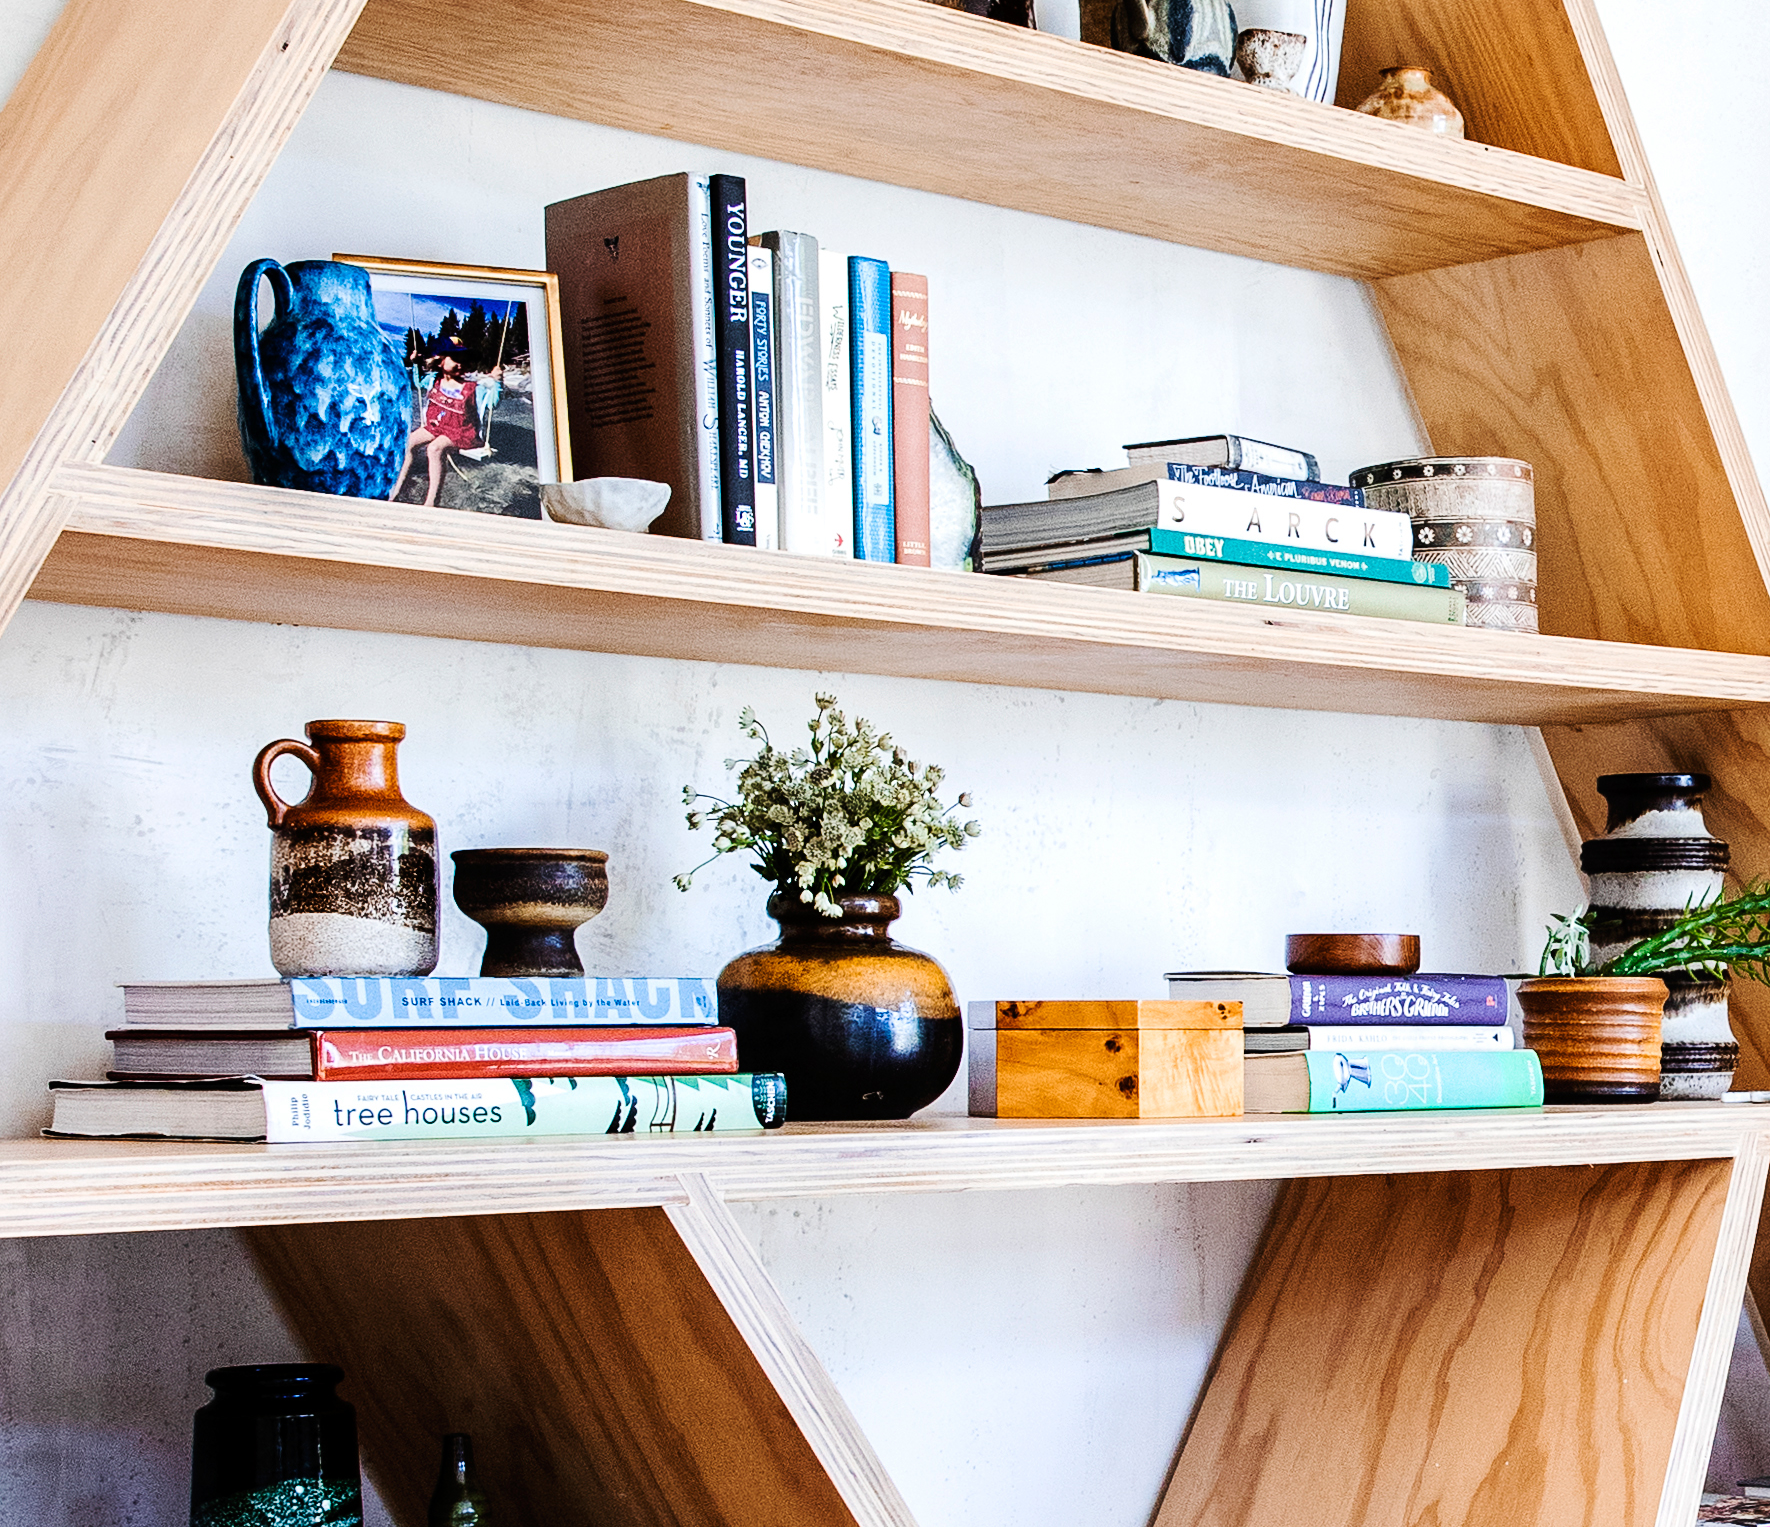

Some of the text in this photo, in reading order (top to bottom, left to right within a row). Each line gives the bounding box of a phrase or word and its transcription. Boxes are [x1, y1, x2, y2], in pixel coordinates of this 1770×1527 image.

[701, 212, 709, 239] Love
[702, 241, 710, 273] Poems
[727, 202, 748, 323] YOUNGER
[704, 277, 712, 297] and
[704, 297, 714, 337] Sonnets
[753, 300, 769, 382] FORTY STORIES
[735, 349, 747, 401] HAROLD
[758, 390, 772, 479] ANTON CHEKHOV
[739, 458, 749, 479] MD
[1173, 463, 1302, 499] The Footloose American
[1172, 496, 1376, 548] SARCK
[1183, 535, 1225, 559] OBEY
[1275, 552, 1361, 571] E PLURIBUS VENOM
[1223, 574, 1351, 610] THE LOUVRE
[401, 997, 435, 1007] SURF
[439, 997, 483, 1007] SHACK
[499, 998, 641, 1009] Laid-Back Living by the Water
[1301, 980, 1313, 1018] GRIMM
[1341, 994, 1358, 1008] The
[1358, 982, 1393, 1001] Original
[1350, 995, 1402, 1018] BROTHERS
[349, 1044, 528, 1063] THE CALIFORNIA HOUSE
[1327, 1034, 1388, 1043] FRIDA KAHLO
[1526, 1060, 1537, 1096] TASCHEN
[291, 1096, 300, 1127] Philip
[303, 1093, 312, 1130] Jodidio
[333, 1089, 502, 1126] tree houses
[357, 1092, 482, 1102] FAIRY TALE CASTLES IN THE AIR
[764, 1080, 776, 1124] TASCHEN
